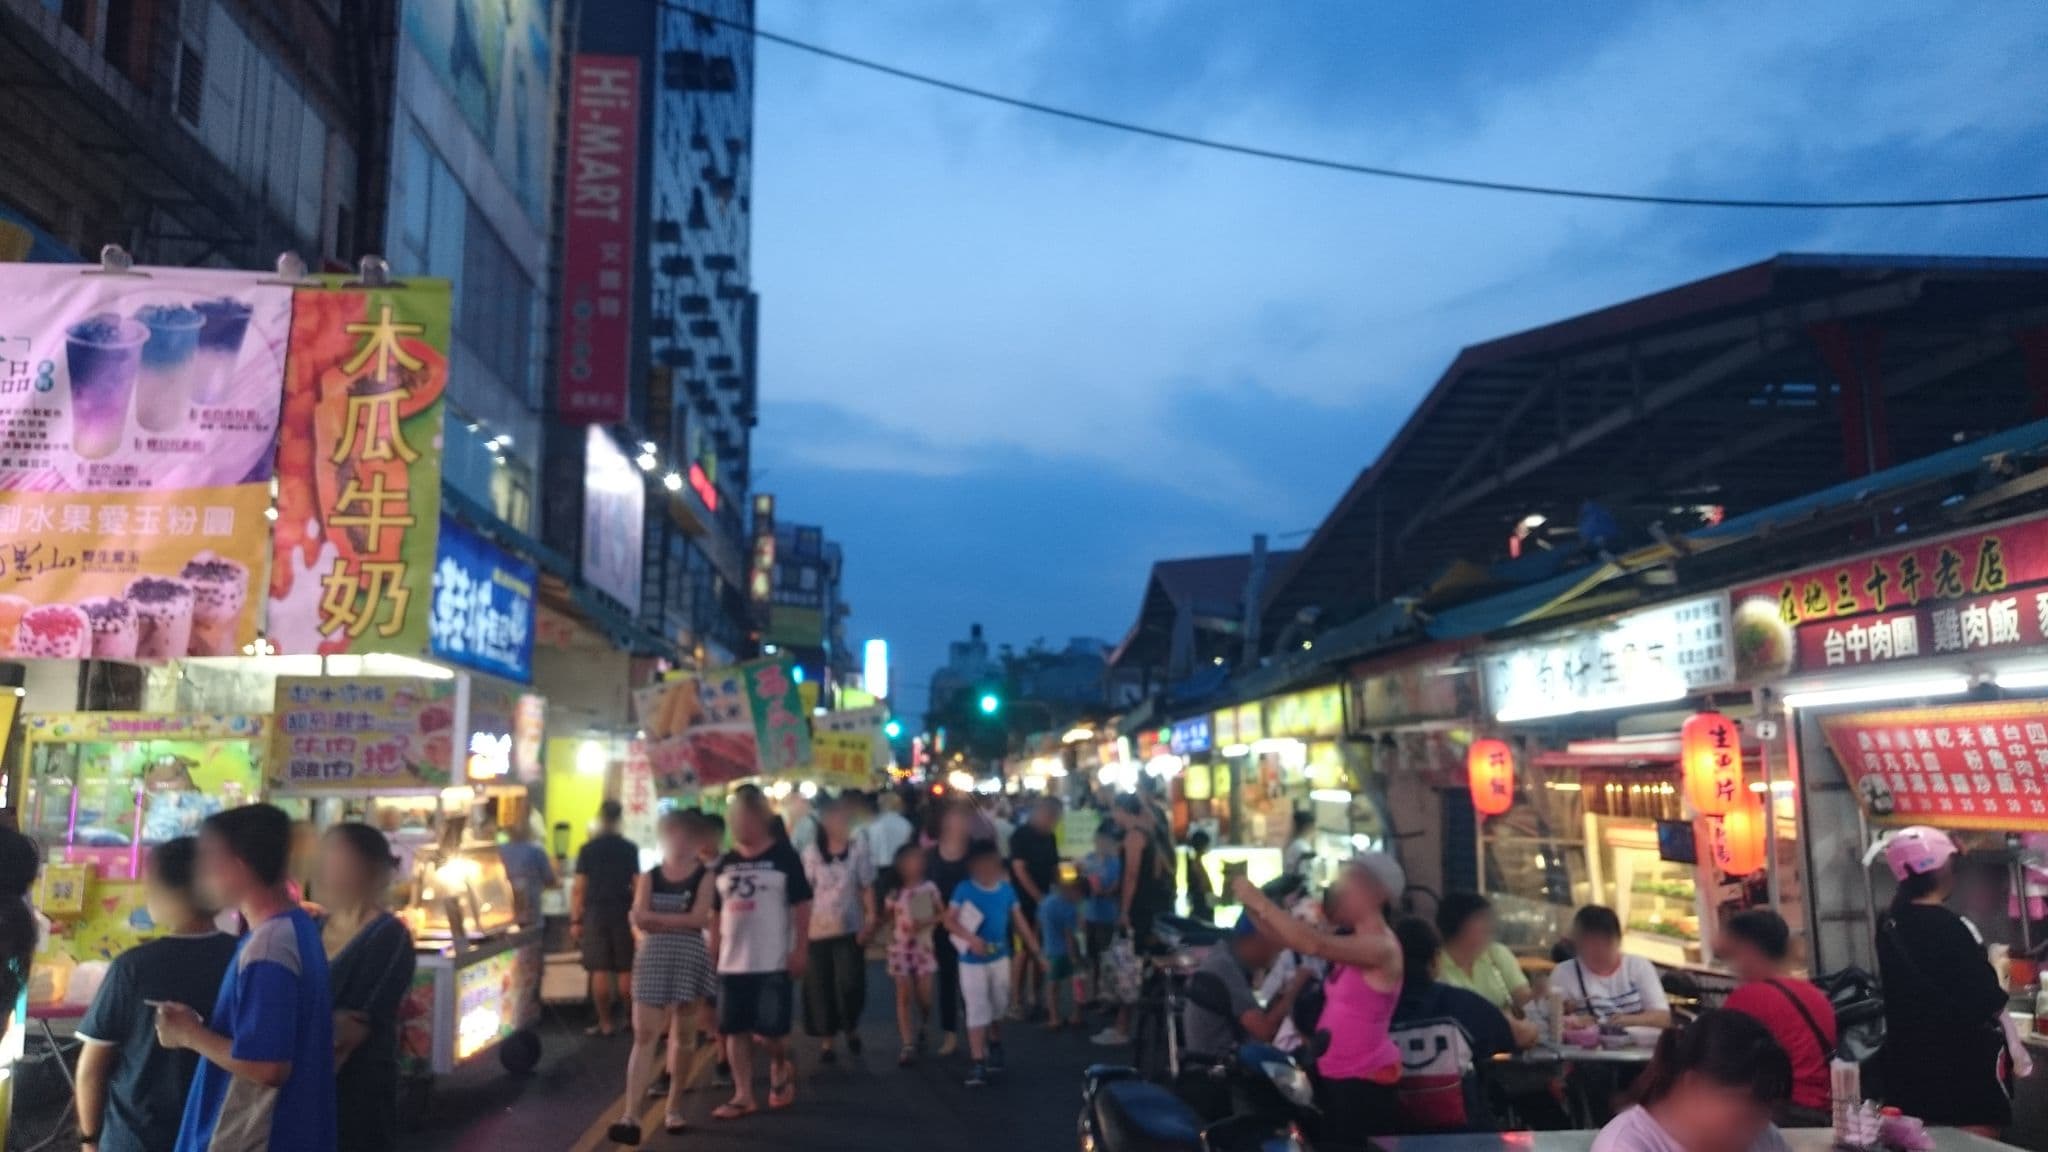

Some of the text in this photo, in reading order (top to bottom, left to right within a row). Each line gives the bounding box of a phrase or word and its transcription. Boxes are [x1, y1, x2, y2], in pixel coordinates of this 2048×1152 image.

[319, 304, 425, 638] 木瓜牛奶
[1778, 536, 2007, 628] 在地三十年老店
[1824, 615, 1918, 667] 台中肉圓
[1932, 597, 2020, 652] 雞肉飯
